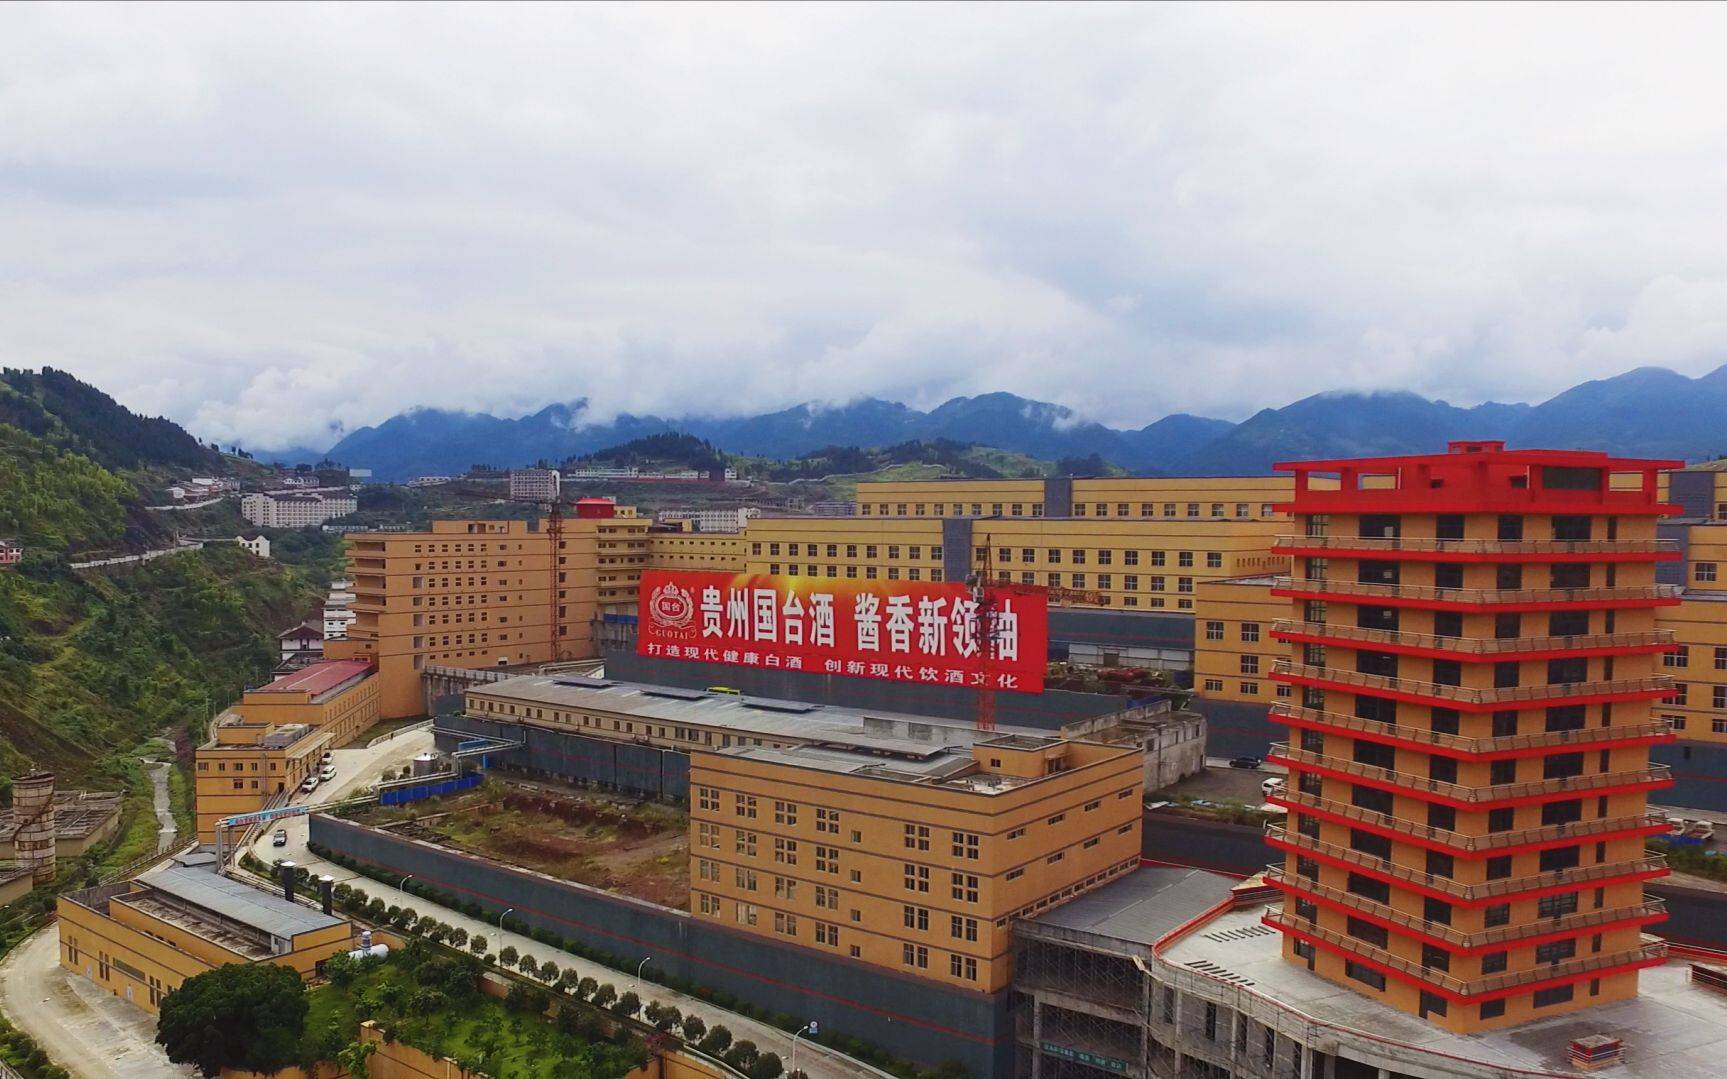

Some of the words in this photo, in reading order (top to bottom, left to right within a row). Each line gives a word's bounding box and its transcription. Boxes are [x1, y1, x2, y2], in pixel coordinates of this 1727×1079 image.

[661, 601, 680, 612] 国台
[700, 585, 835, 648] 贵州国台酒
[648, 642, 802, 670] 打造现代健康白酒
[825, 659, 1018, 689] 创新现代饮酒文化
